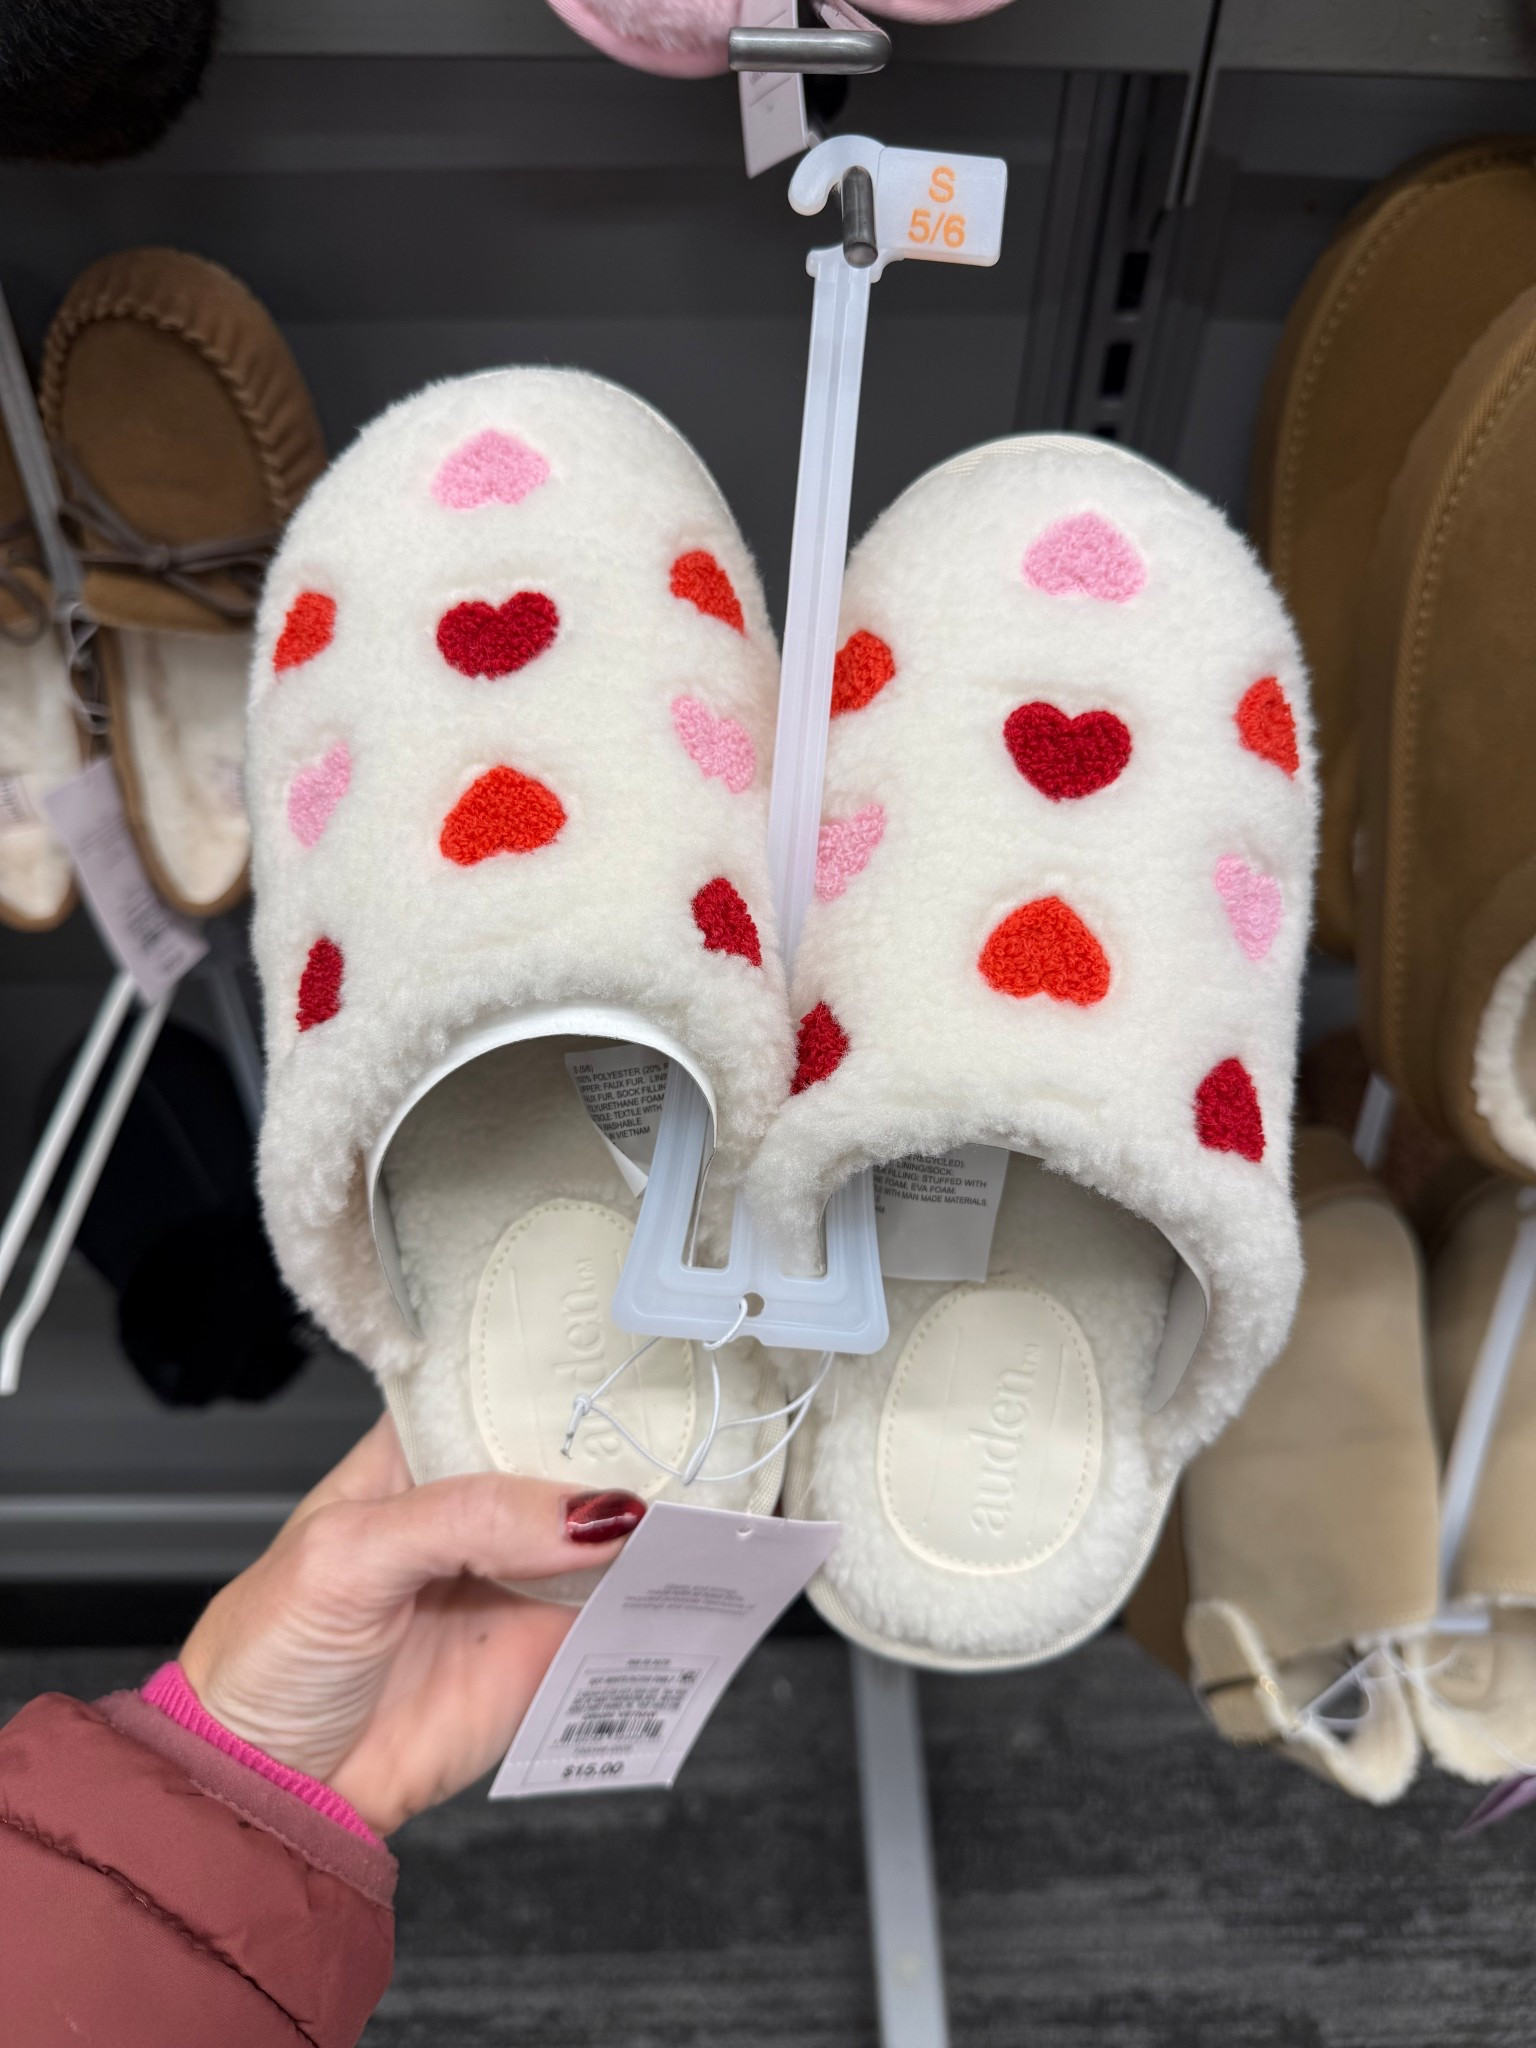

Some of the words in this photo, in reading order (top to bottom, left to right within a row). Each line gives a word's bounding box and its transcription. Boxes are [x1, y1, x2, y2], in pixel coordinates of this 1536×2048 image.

[928, 165, 955, 204] S
[907, 208, 966, 249] 5/6
[593, 1067, 641, 1082] POLYESTER
[604, 1080, 624, 1090] FAUX
[617, 1088, 640, 1098] SOCK
[614, 1107, 642, 1119] TEXTILE
[642, 1104, 663, 1114] WITH
[603, 1117, 642, 1131] WASHABLE
[616, 1126, 650, 1139] VIETNAM
[911, 1182, 927, 1193] EVA
[921, 1175, 962, 1186] STUFFED
[964, 1179, 987, 1188] WITH
[902, 1191, 918, 1200] MAN
[921, 1195, 942, 1203] MADE
[561, 1761, 625, 1778] $15.00
